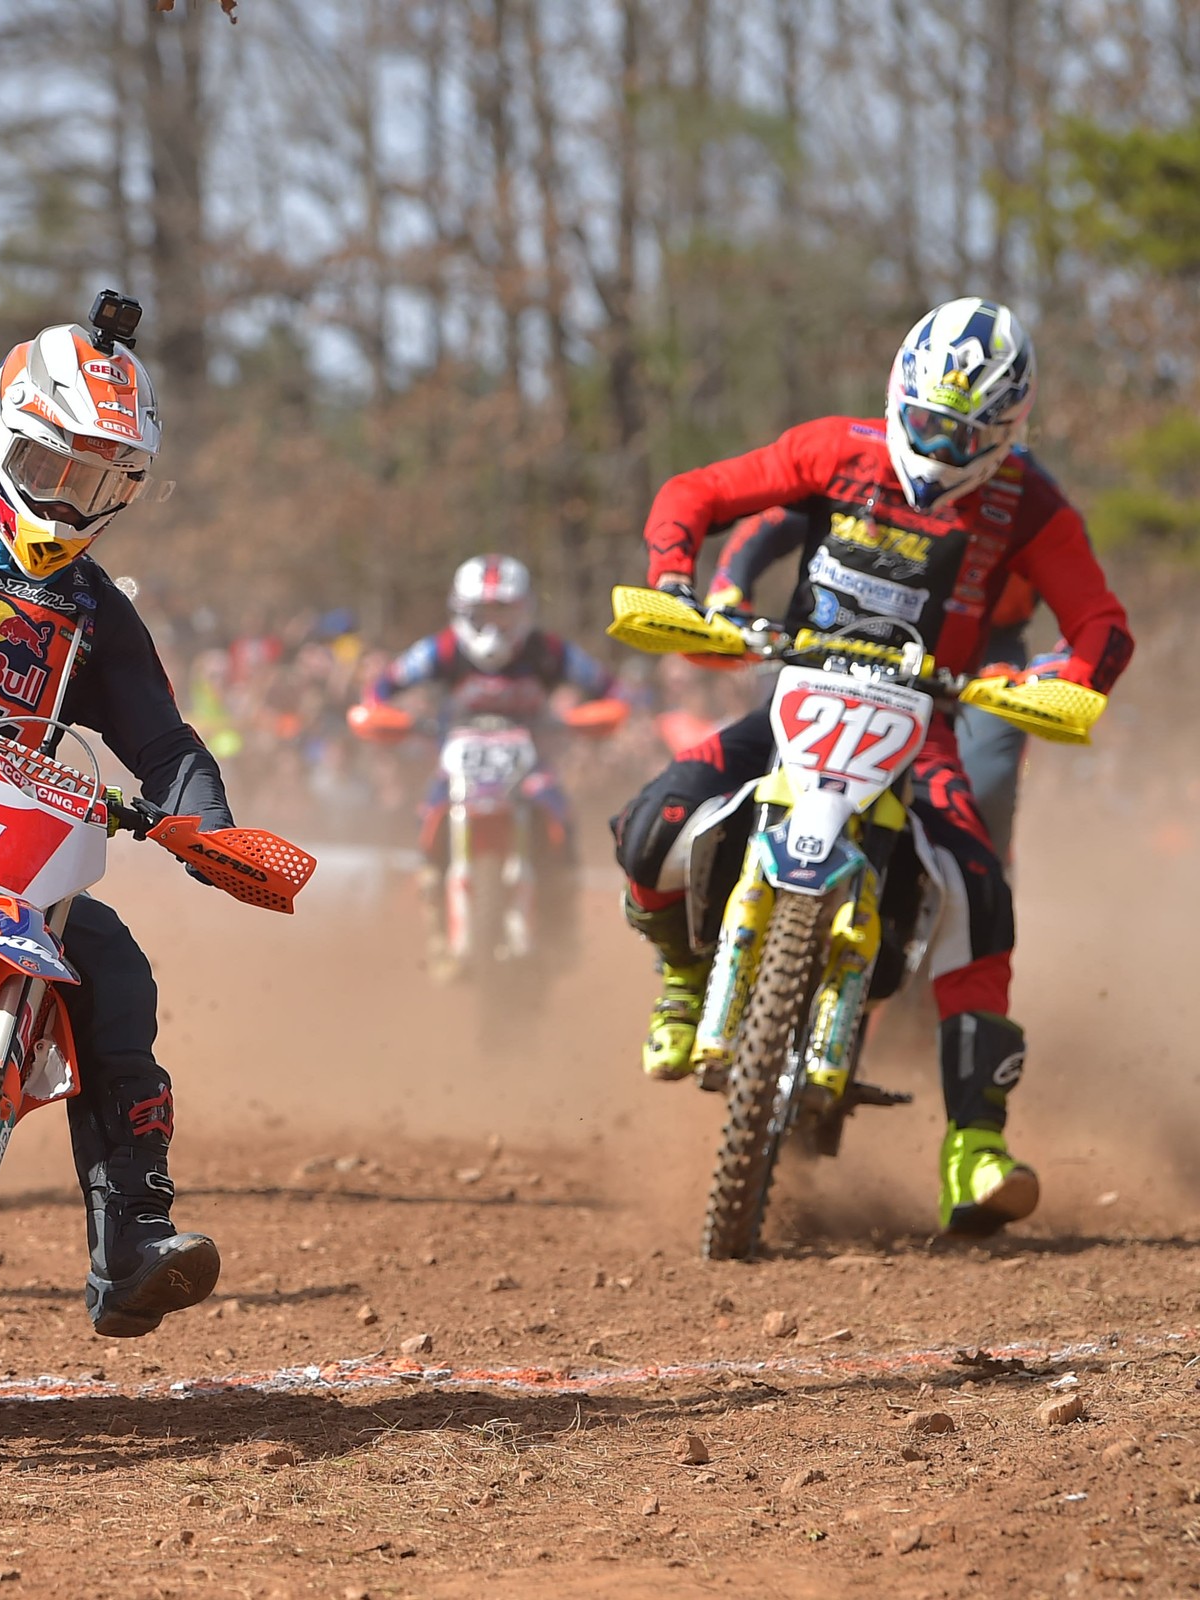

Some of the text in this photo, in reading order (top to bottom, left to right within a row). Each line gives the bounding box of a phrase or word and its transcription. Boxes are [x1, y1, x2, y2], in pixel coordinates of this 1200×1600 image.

[90, 363, 125, 381] BELL
[97, 400, 134, 418] KTM
[102, 420, 137, 438] BELL
[5, 578, 77, 612] Designs
[788, 694, 915, 785] 212
